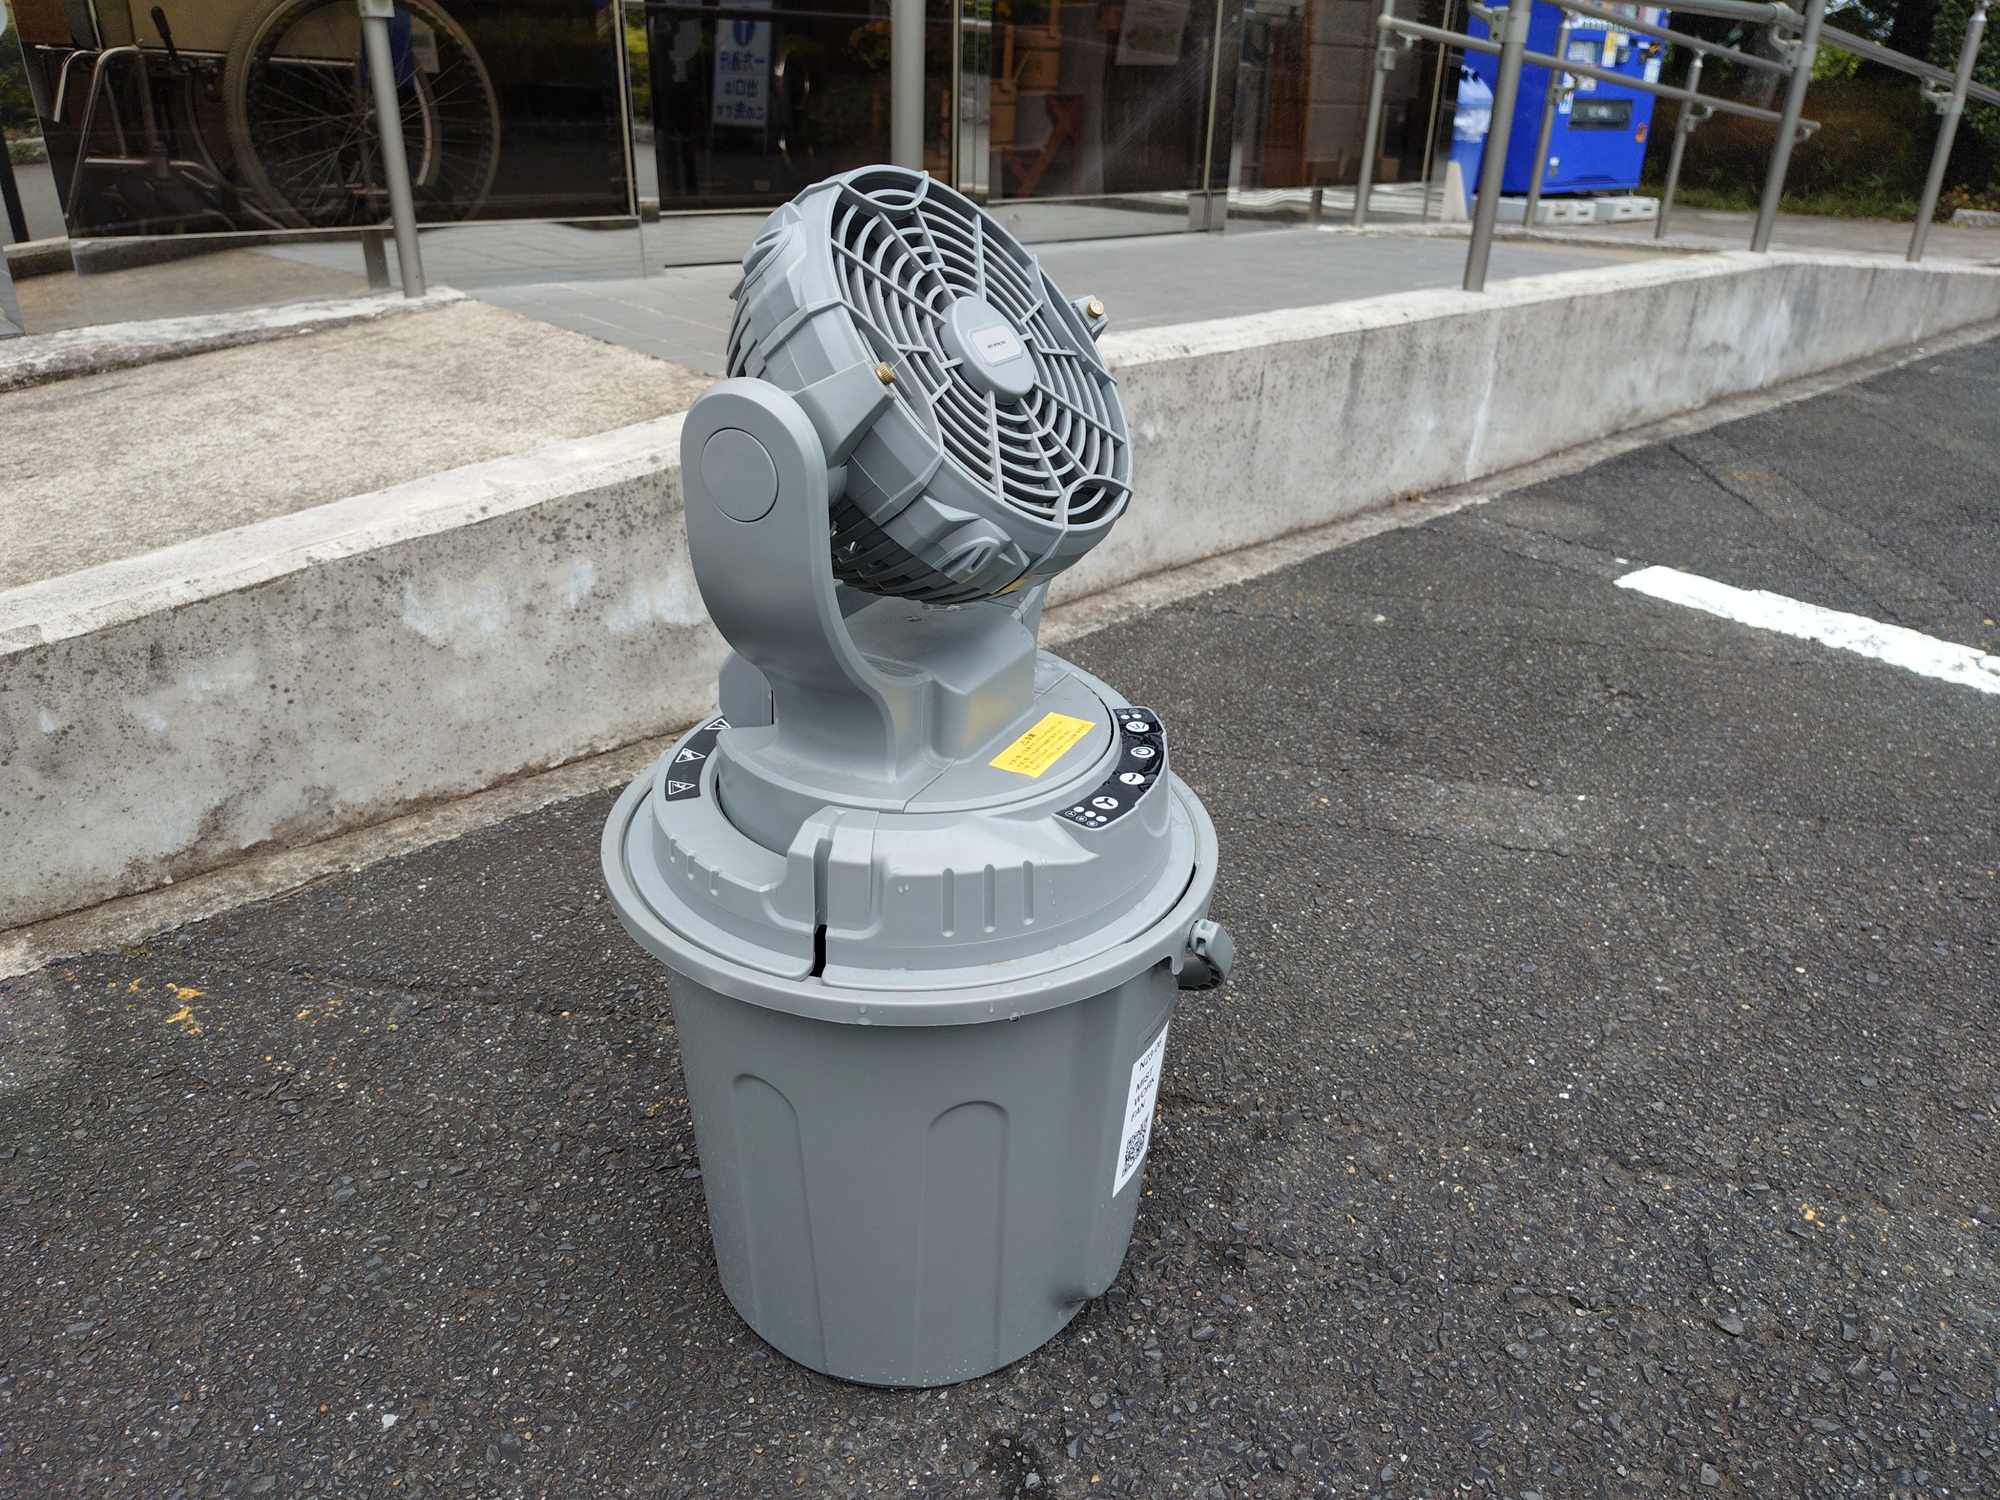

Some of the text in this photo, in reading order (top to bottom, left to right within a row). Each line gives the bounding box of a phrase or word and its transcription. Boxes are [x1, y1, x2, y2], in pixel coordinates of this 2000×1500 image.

[1134, 1073, 1156, 1106] WORK
[1135, 1065, 1154, 1093] MIST
[1131, 1098, 1146, 1122] FAN
